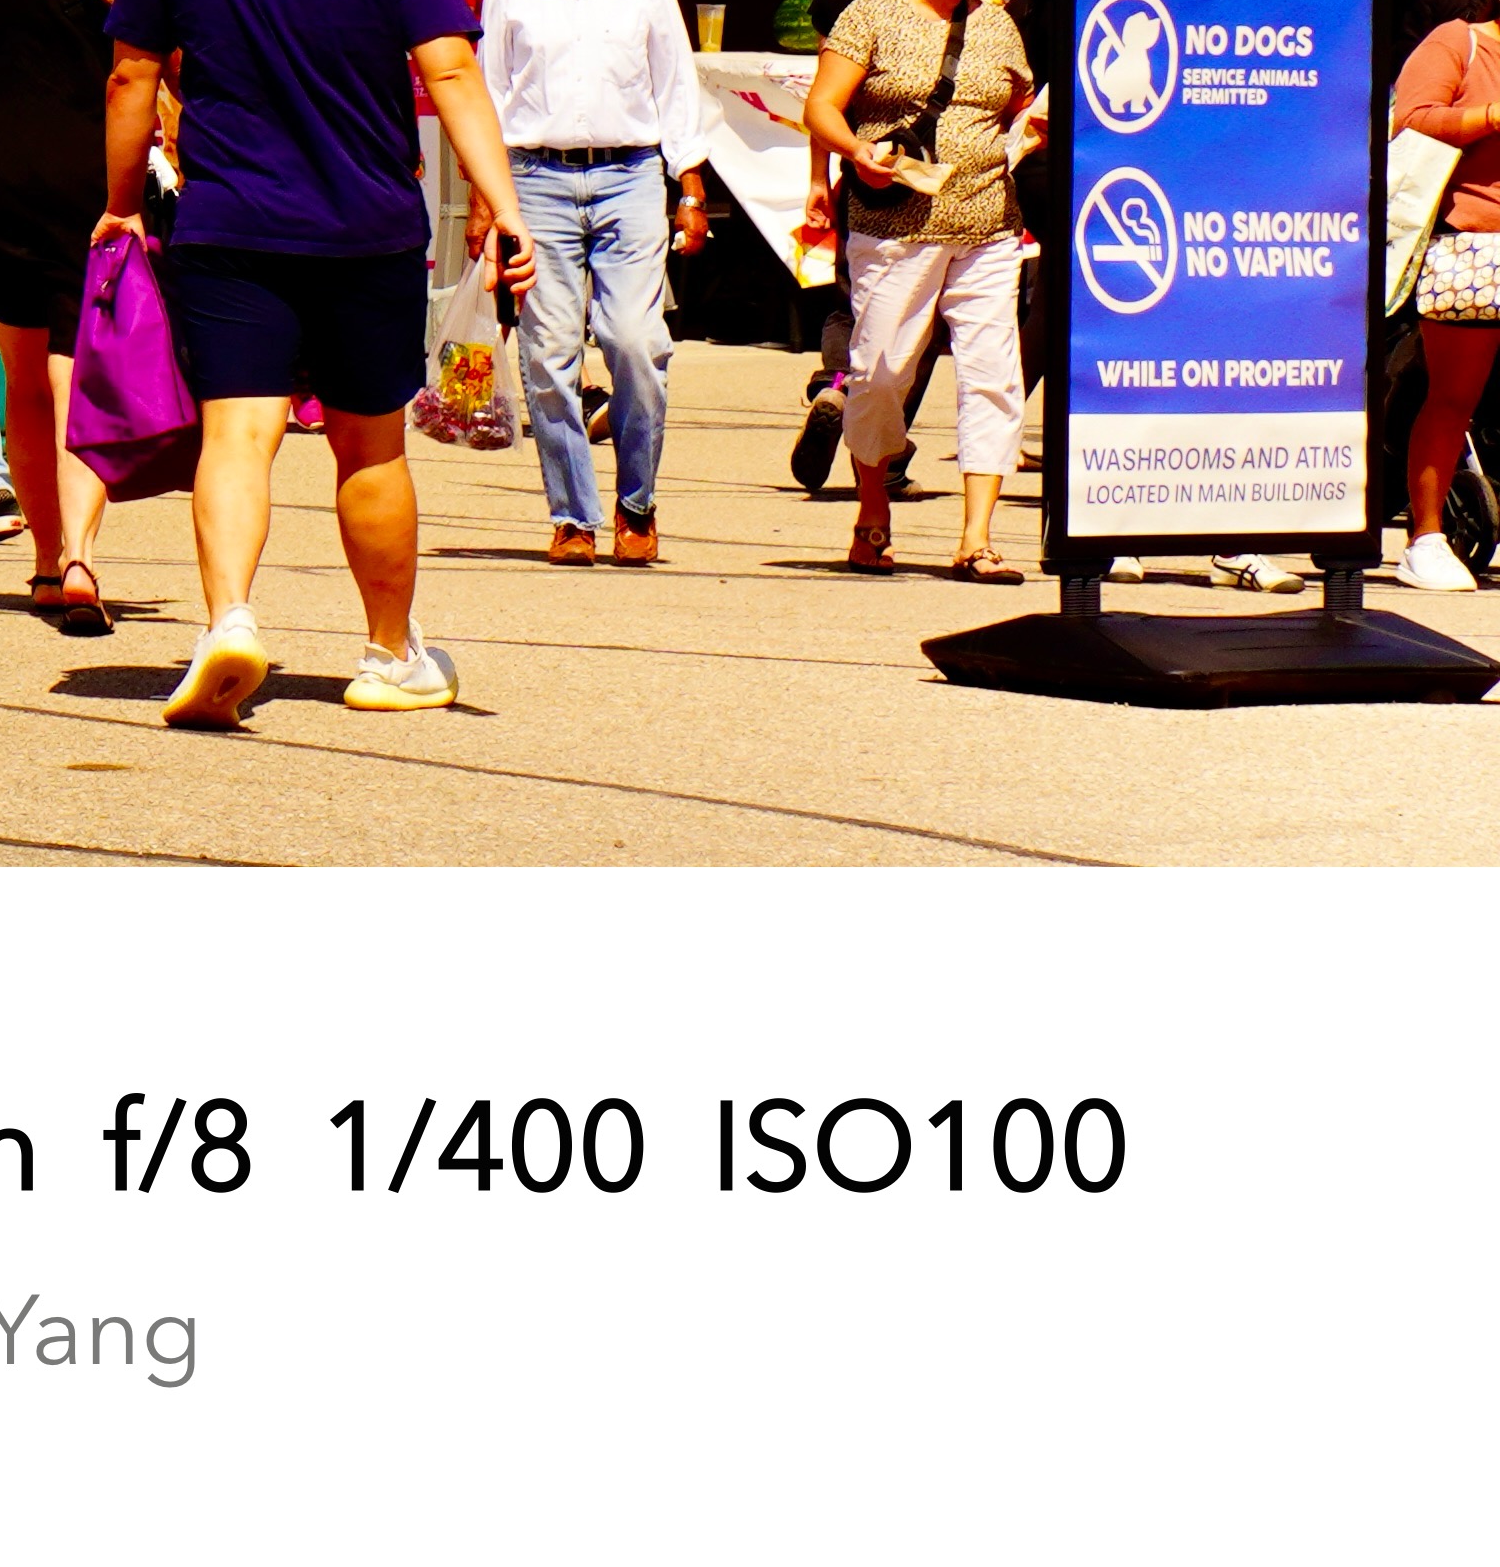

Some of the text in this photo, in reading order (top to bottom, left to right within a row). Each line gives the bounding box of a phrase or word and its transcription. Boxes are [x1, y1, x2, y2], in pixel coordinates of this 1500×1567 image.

[1185, 24, 1313, 57] NO DOGS
[1182, 68, 1318, 87] SERVICE ANIMALS
[1182, 87, 1268, 105] PERMITTED
[1183, 210, 1360, 243] NO SMOKING
[1185, 246, 1334, 278] NO VAPING
[1097, 358, 1344, 388] WHILE ON PROPERTY
[1082, 445, 1352, 472] WASHROOMS AND ATMS
[1087, 482, 1347, 505] LOCATED IN MAIN BUILDINGS
